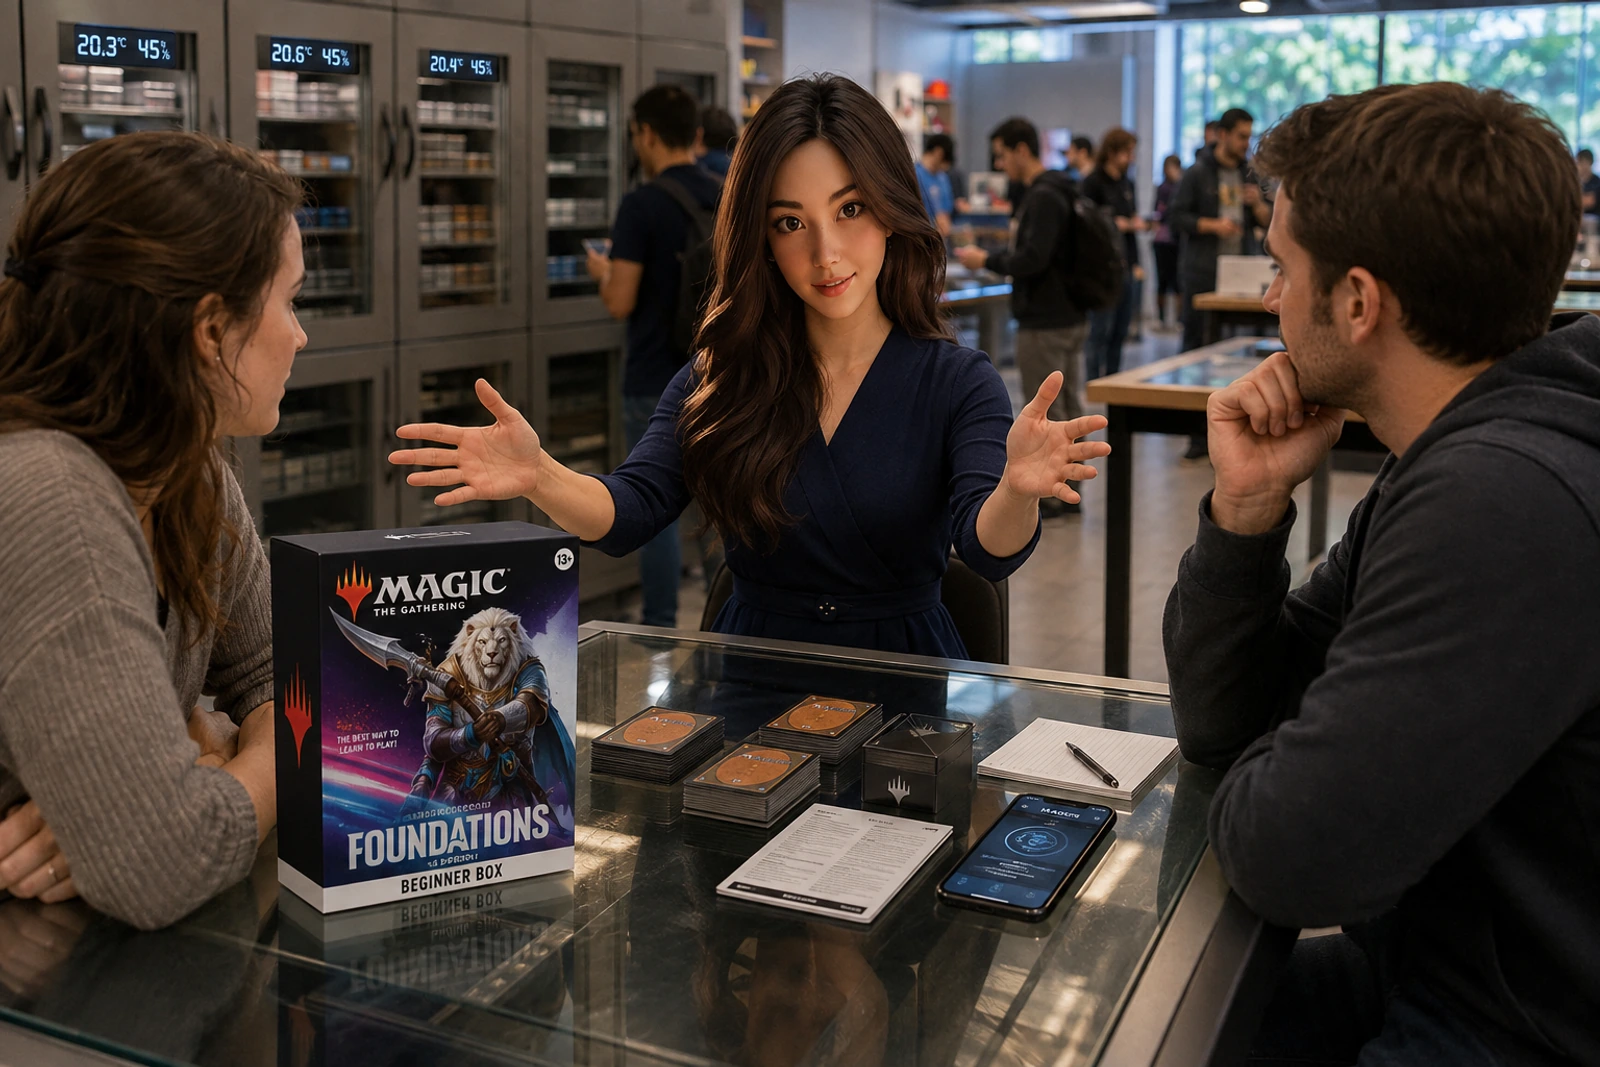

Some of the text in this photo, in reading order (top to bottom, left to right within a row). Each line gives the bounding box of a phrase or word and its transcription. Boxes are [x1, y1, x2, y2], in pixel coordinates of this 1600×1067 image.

[556, 553, 573, 566] 13+
[373, 568, 508, 605] MAGIC
[373, 601, 466, 617] THE GATHERING
[337, 735, 351, 744] THE
[389, 729, 400, 738] TO
[365, 742, 375, 751] TO
[347, 804, 550, 870] FOUNDATIONS
[401, 863, 503, 894] BEGINNER BOX
